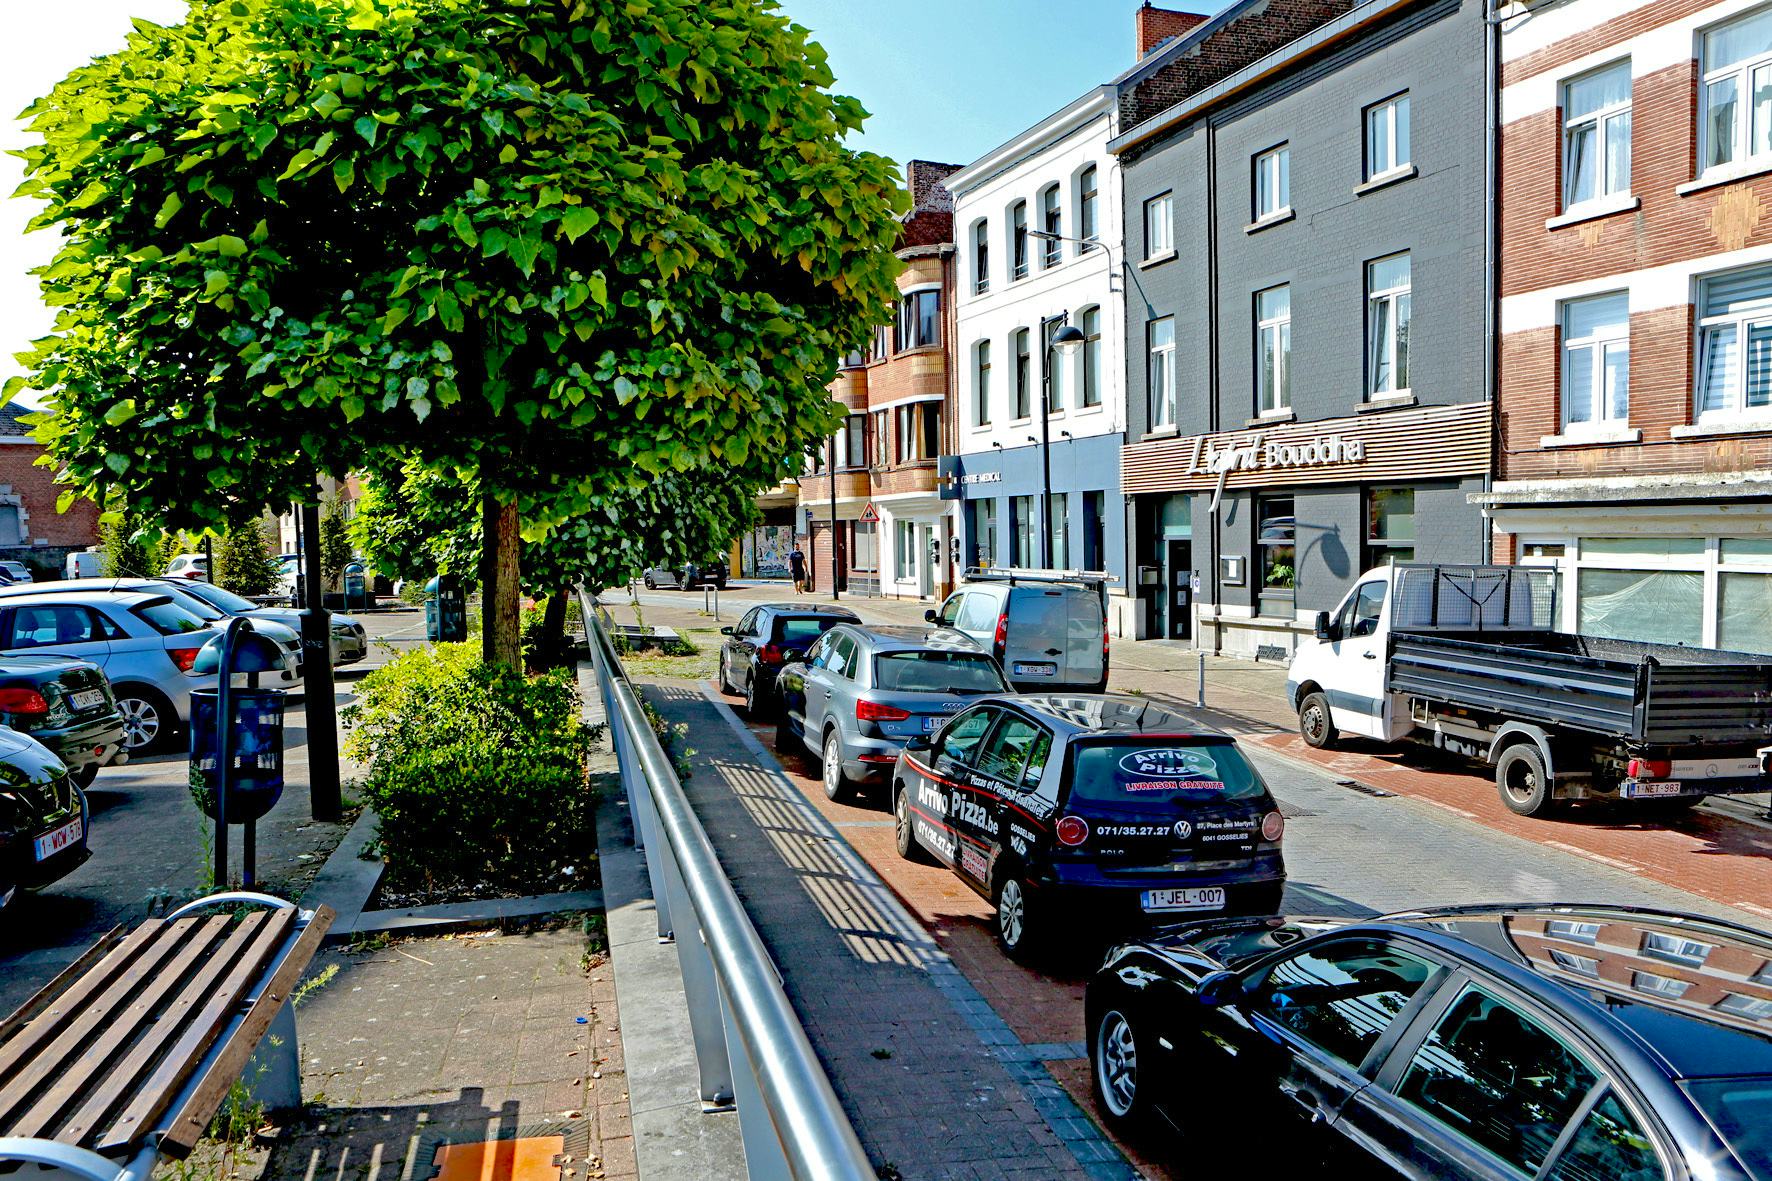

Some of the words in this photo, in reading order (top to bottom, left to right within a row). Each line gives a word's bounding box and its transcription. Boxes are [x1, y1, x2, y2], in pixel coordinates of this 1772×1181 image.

[1265, 435, 1366, 467] Bouddha
[1134, 751, 1200, 764] Arrivo
[1140, 763, 1201, 774] Pizza
[1126, 781, 1177, 791] LIVRAISON
[1179, 780, 1225, 790] GRATUITE
[918, 778, 949, 815] Arrivo
[1096, 826, 1170, 836] 071/35.27.27
[1216, 832, 1249, 841] GOSSELIES
